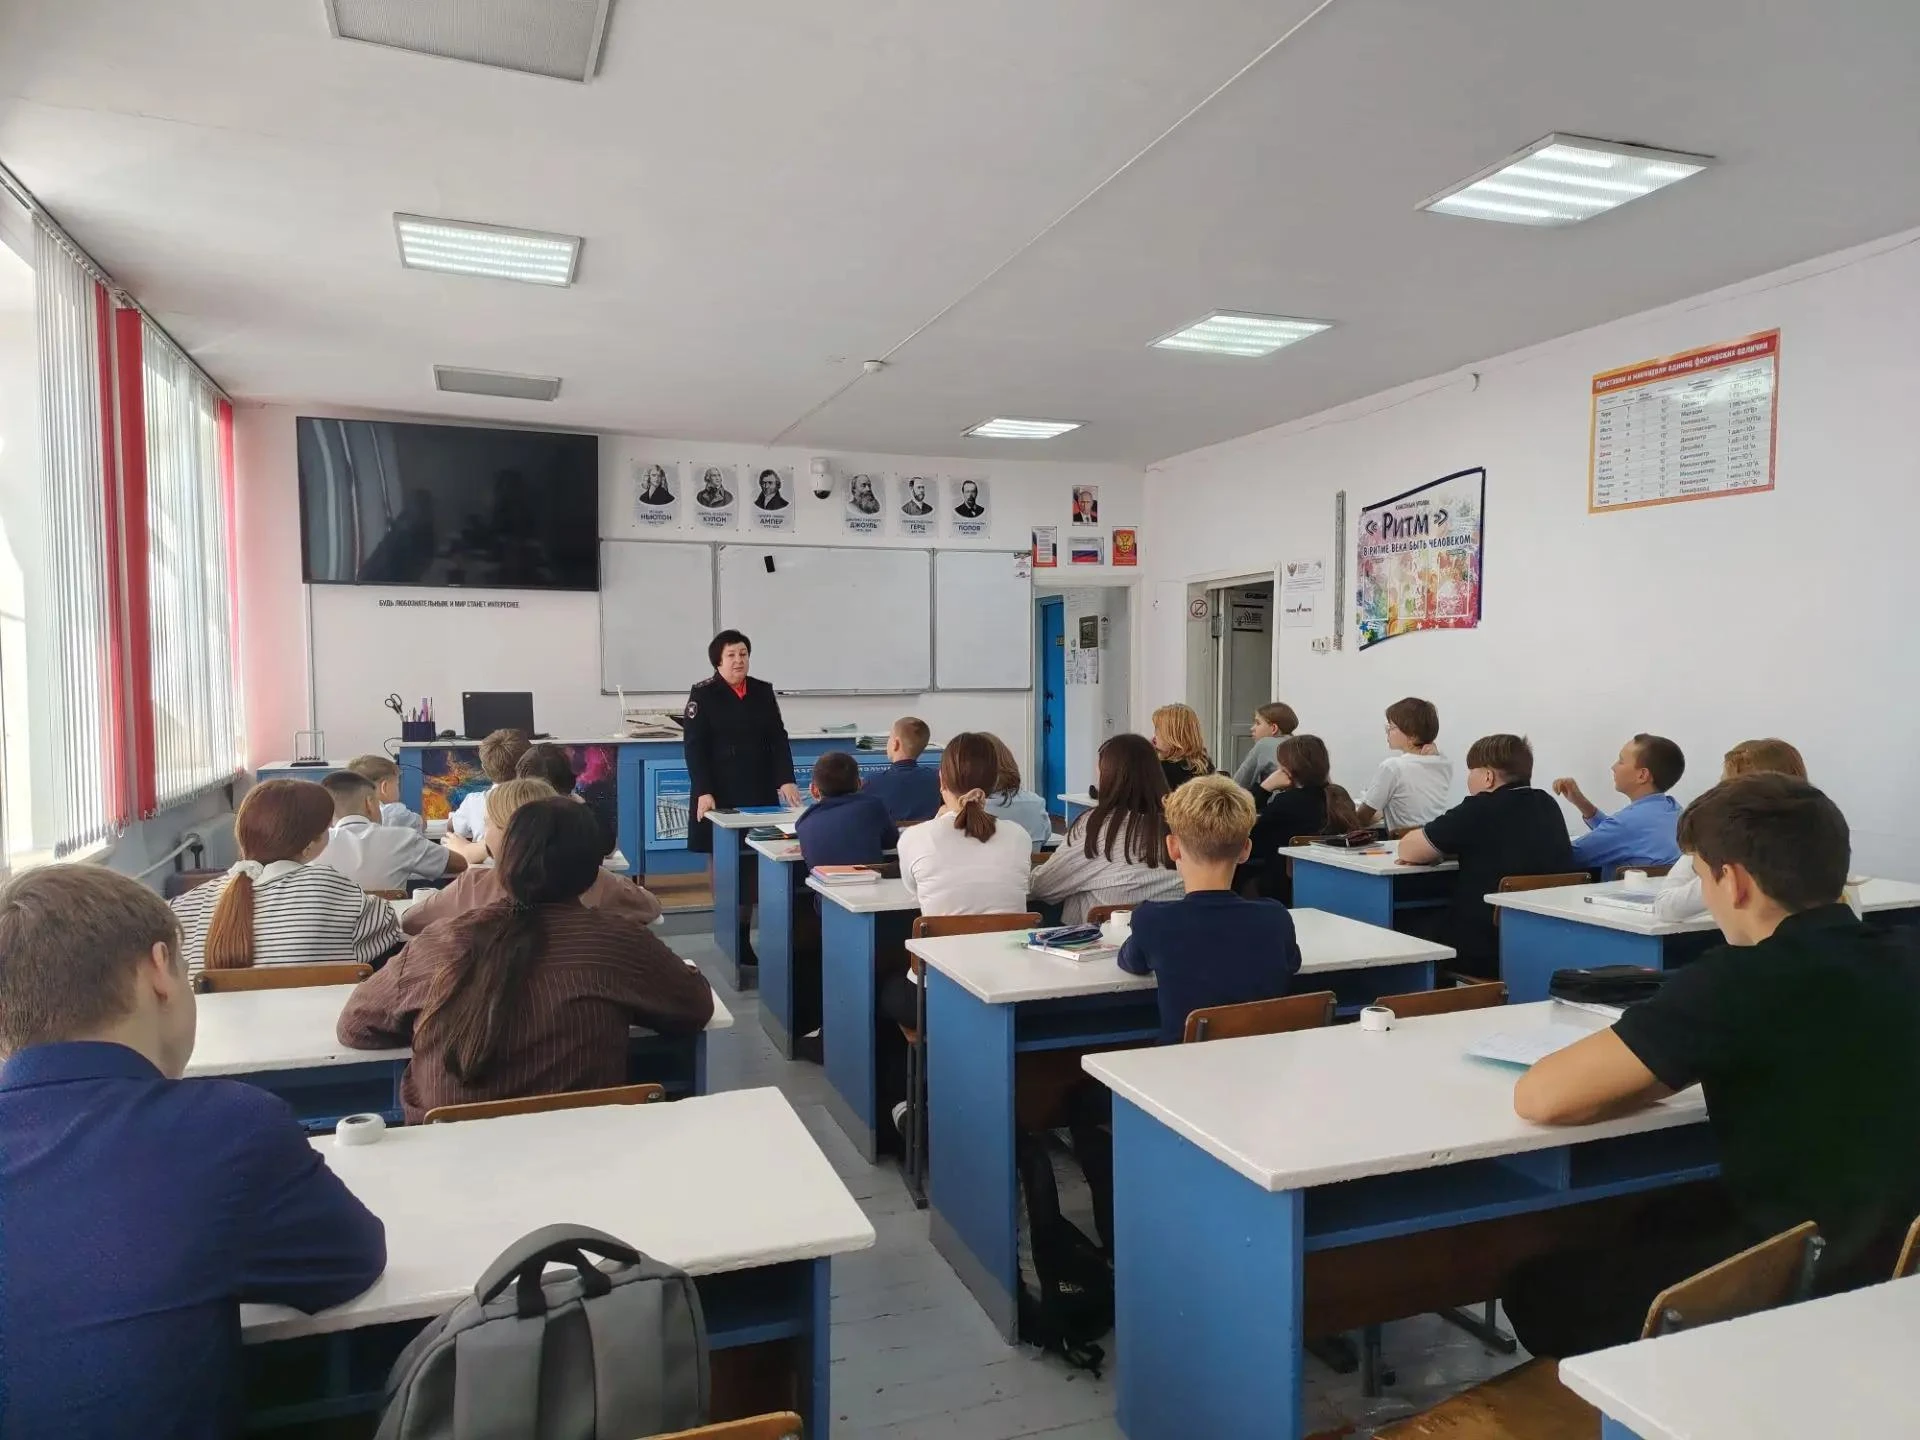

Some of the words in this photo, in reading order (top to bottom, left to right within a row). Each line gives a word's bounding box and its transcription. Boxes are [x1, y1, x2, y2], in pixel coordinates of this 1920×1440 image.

[640, 513, 672, 521] НЬЮТОН
[849, 521, 878, 529] ДЖОУЛЬ
[910, 523, 926, 531] ГЕРЦ
[1391, 542, 1407, 553] ВЕКА
[1409, 539, 1428, 551] БЫТЬ
[1429, 534, 1472, 548] ЧЕЛОВЕКОМ
[454, 600, 466, 608] МИР
[466, 600, 486, 608] СТАНЕТ
